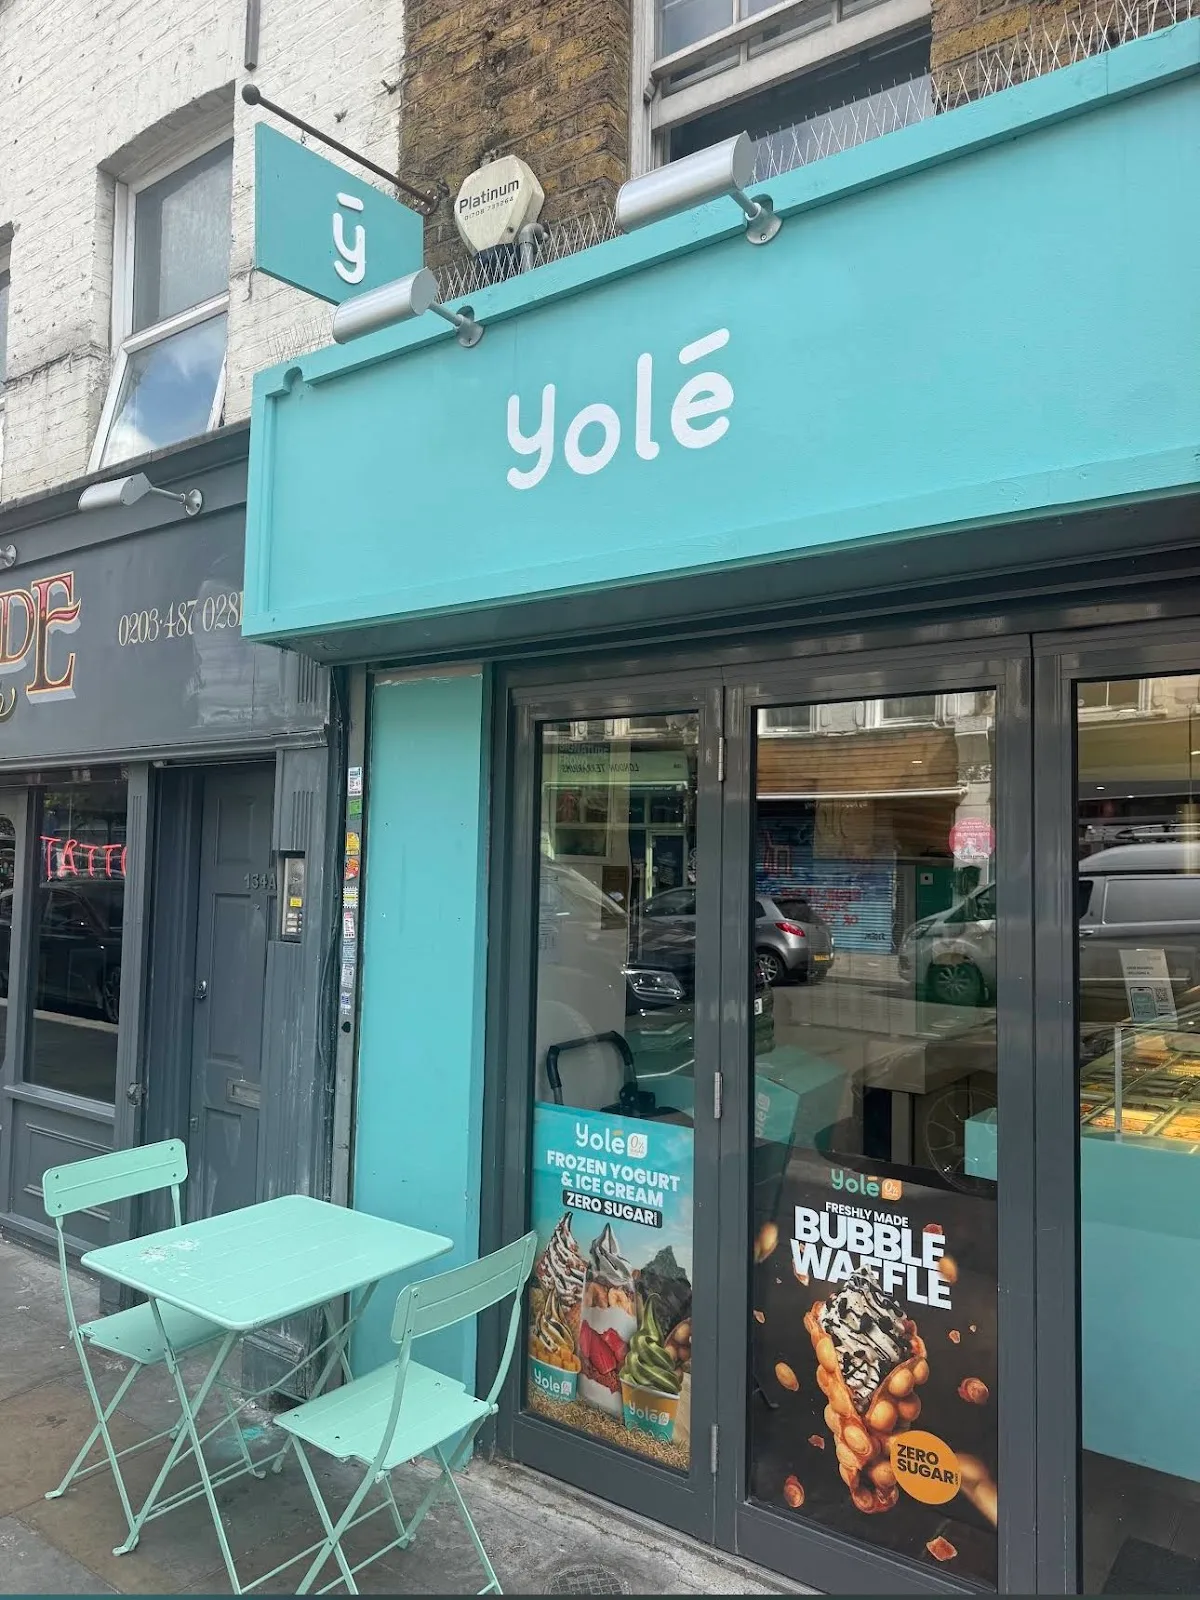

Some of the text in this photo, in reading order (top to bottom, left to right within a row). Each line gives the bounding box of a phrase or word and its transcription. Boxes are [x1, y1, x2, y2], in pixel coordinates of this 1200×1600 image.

[459, 180, 519, 213] Platinum
[507, 328, 735, 490] yolé
[243, 872, 277, 890] 134A
[547, 1150, 680, 1192] FROZEN YOGURT
[561, 1170, 663, 1208] & ICE CREAM
[566, 1192, 602, 1212] ZERO
[825, 1201, 909, 1228] FRESHLY MADE
[794, 1205, 946, 1271] BUBBLE
[897, 1443, 939, 1466] ZERO
